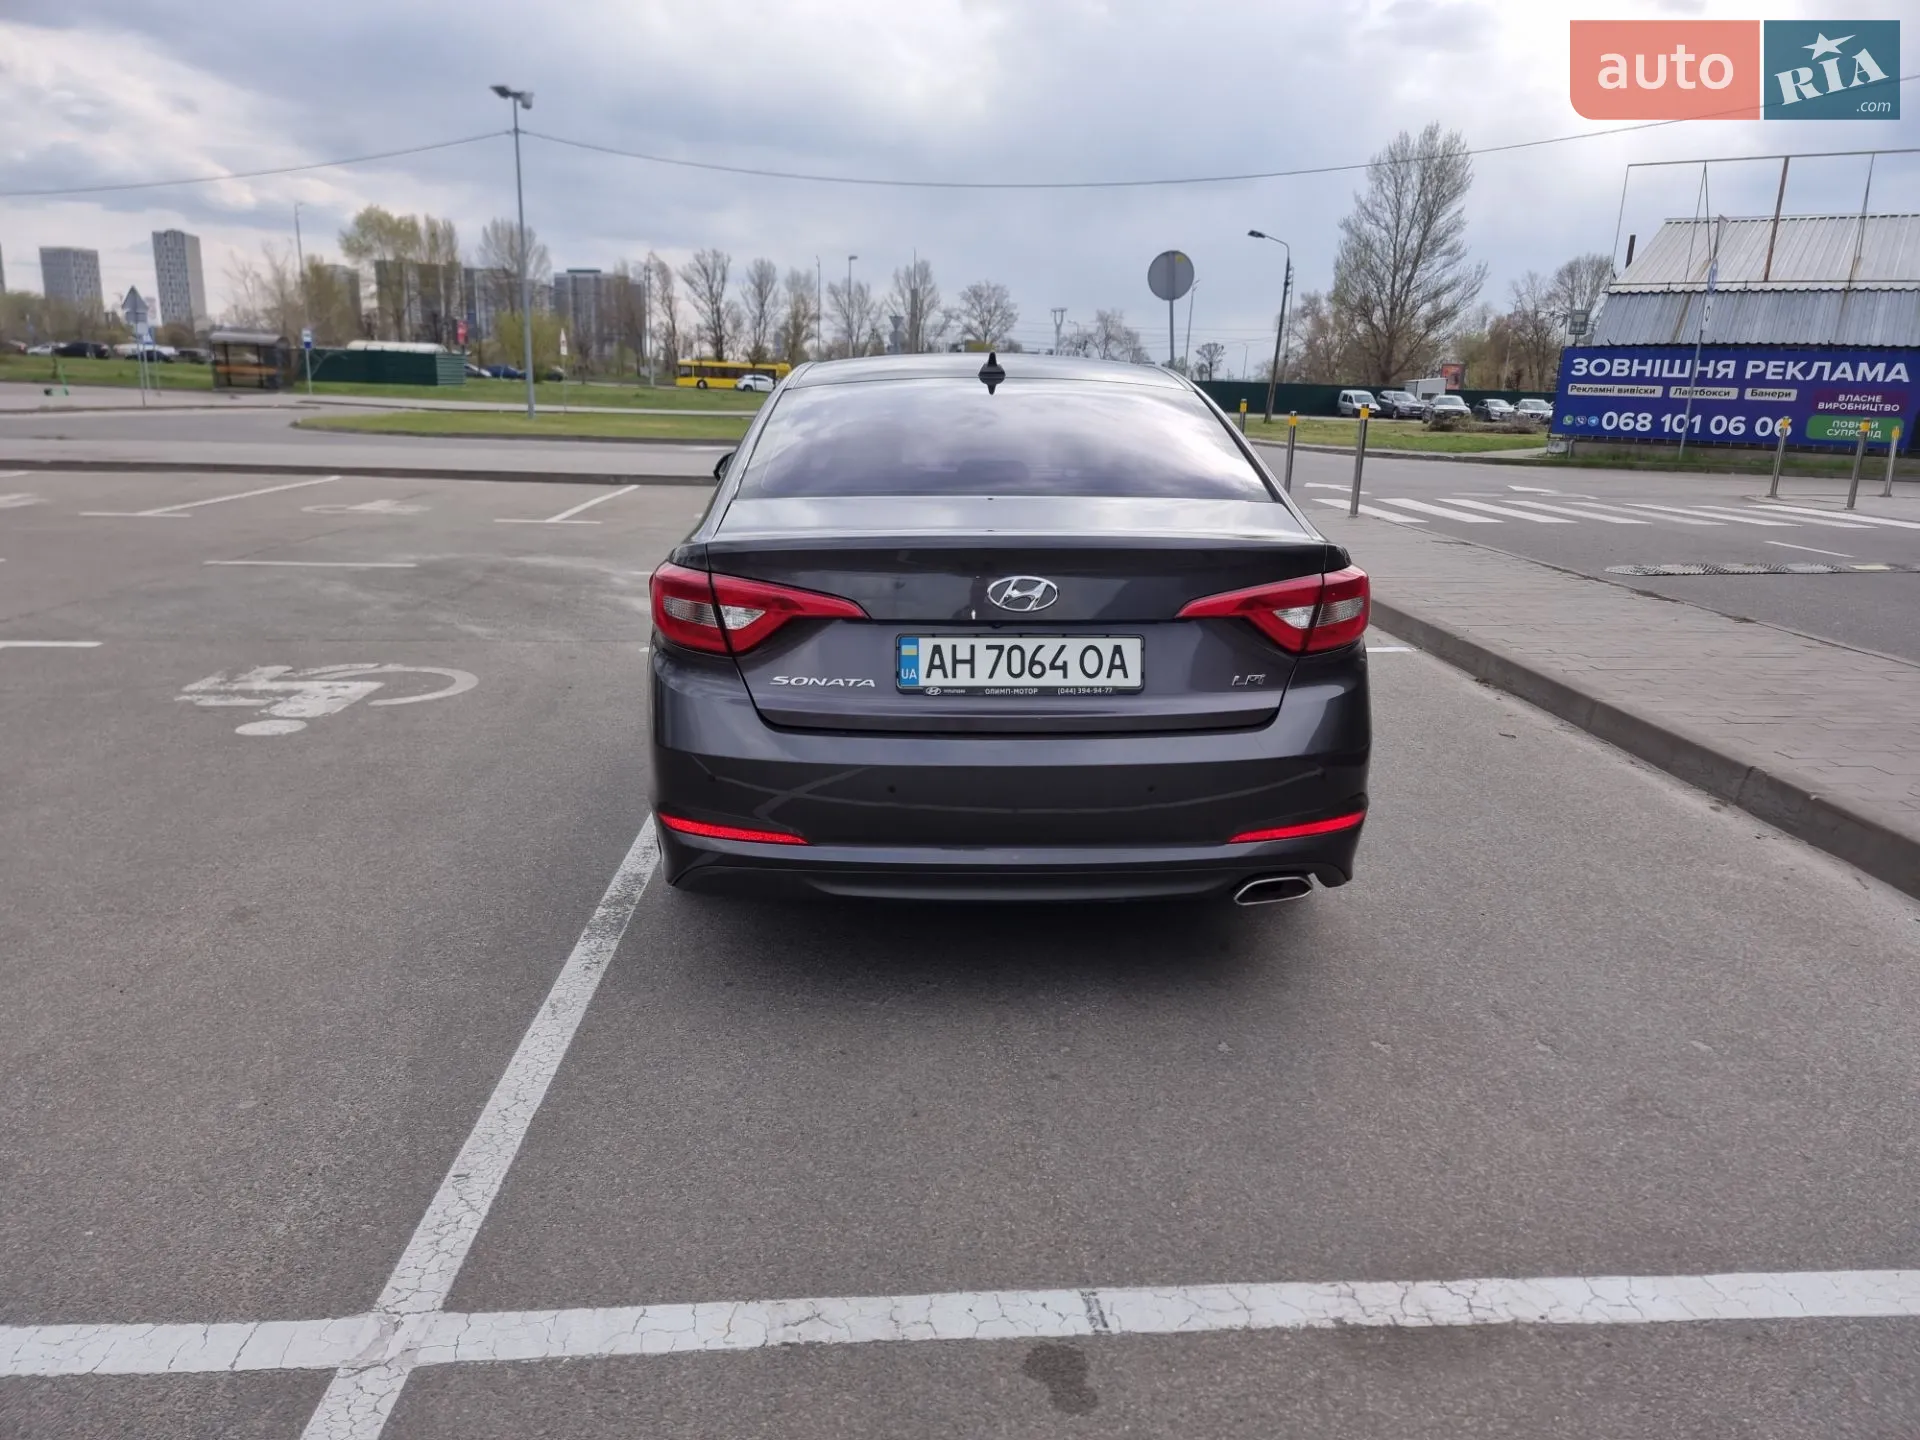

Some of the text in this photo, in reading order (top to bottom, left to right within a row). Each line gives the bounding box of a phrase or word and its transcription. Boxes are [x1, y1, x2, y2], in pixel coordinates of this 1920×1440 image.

[1570, 357, 1911, 383] ЗОВНІШНЯ РЕКЛАМА
[1569, 384, 1656, 395] Рекламні вивіски
[1673, 388, 1731, 397] Латбокси
[1750, 388, 1792, 399] Банери
[1838, 394, 1883, 403] ВЛАСНЕ
[1817, 402, 1900, 412] ВИРОБНИЦТВО
[1601, 411, 1653, 432] 068
[1660, 413, 1702, 434] 101
[1709, 415, 1747, 435] 06
[1832, 420, 1879, 429] ПОВНЙ
[1826, 428, 1882, 438] СУПРОІД
[925, 644, 1129, 680] AH 7064 OA
[901, 668, 918, 680] UA
[769, 675, 876, 688] SONATA
[1057, 687, 1077, 695] (044)
